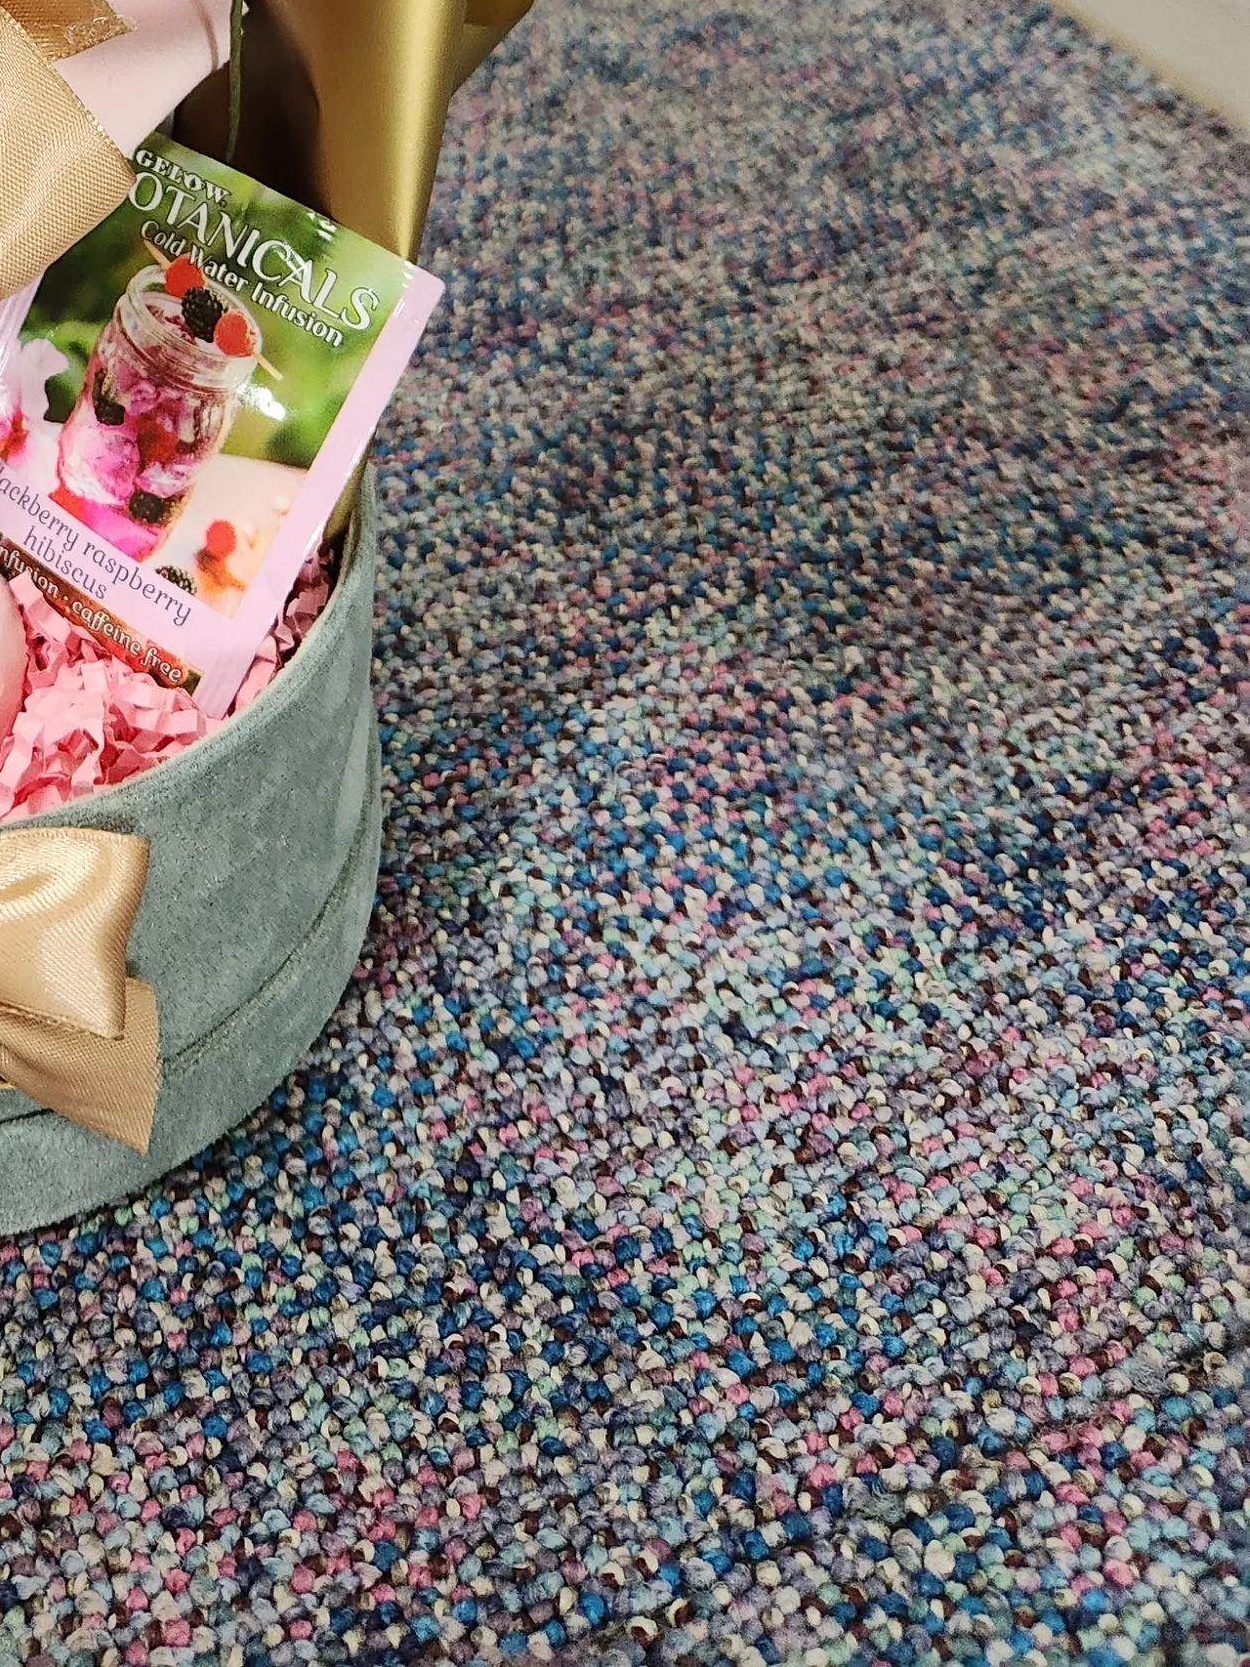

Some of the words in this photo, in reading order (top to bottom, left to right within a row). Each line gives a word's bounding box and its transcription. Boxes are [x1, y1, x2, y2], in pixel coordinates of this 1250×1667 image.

[135, 149, 231, 204] GELOW
[128, 171, 380, 331] OTANICALS
[141, 220, 188, 256] Cold
[187, 244, 249, 292] Water
[251, 284, 344, 348] Infusion
[23, 526, 108, 600] hibiscus
[83, 541, 192, 628] raspberry
[72, 600, 143, 656] caffeine
[141, 648, 183, 684] free
